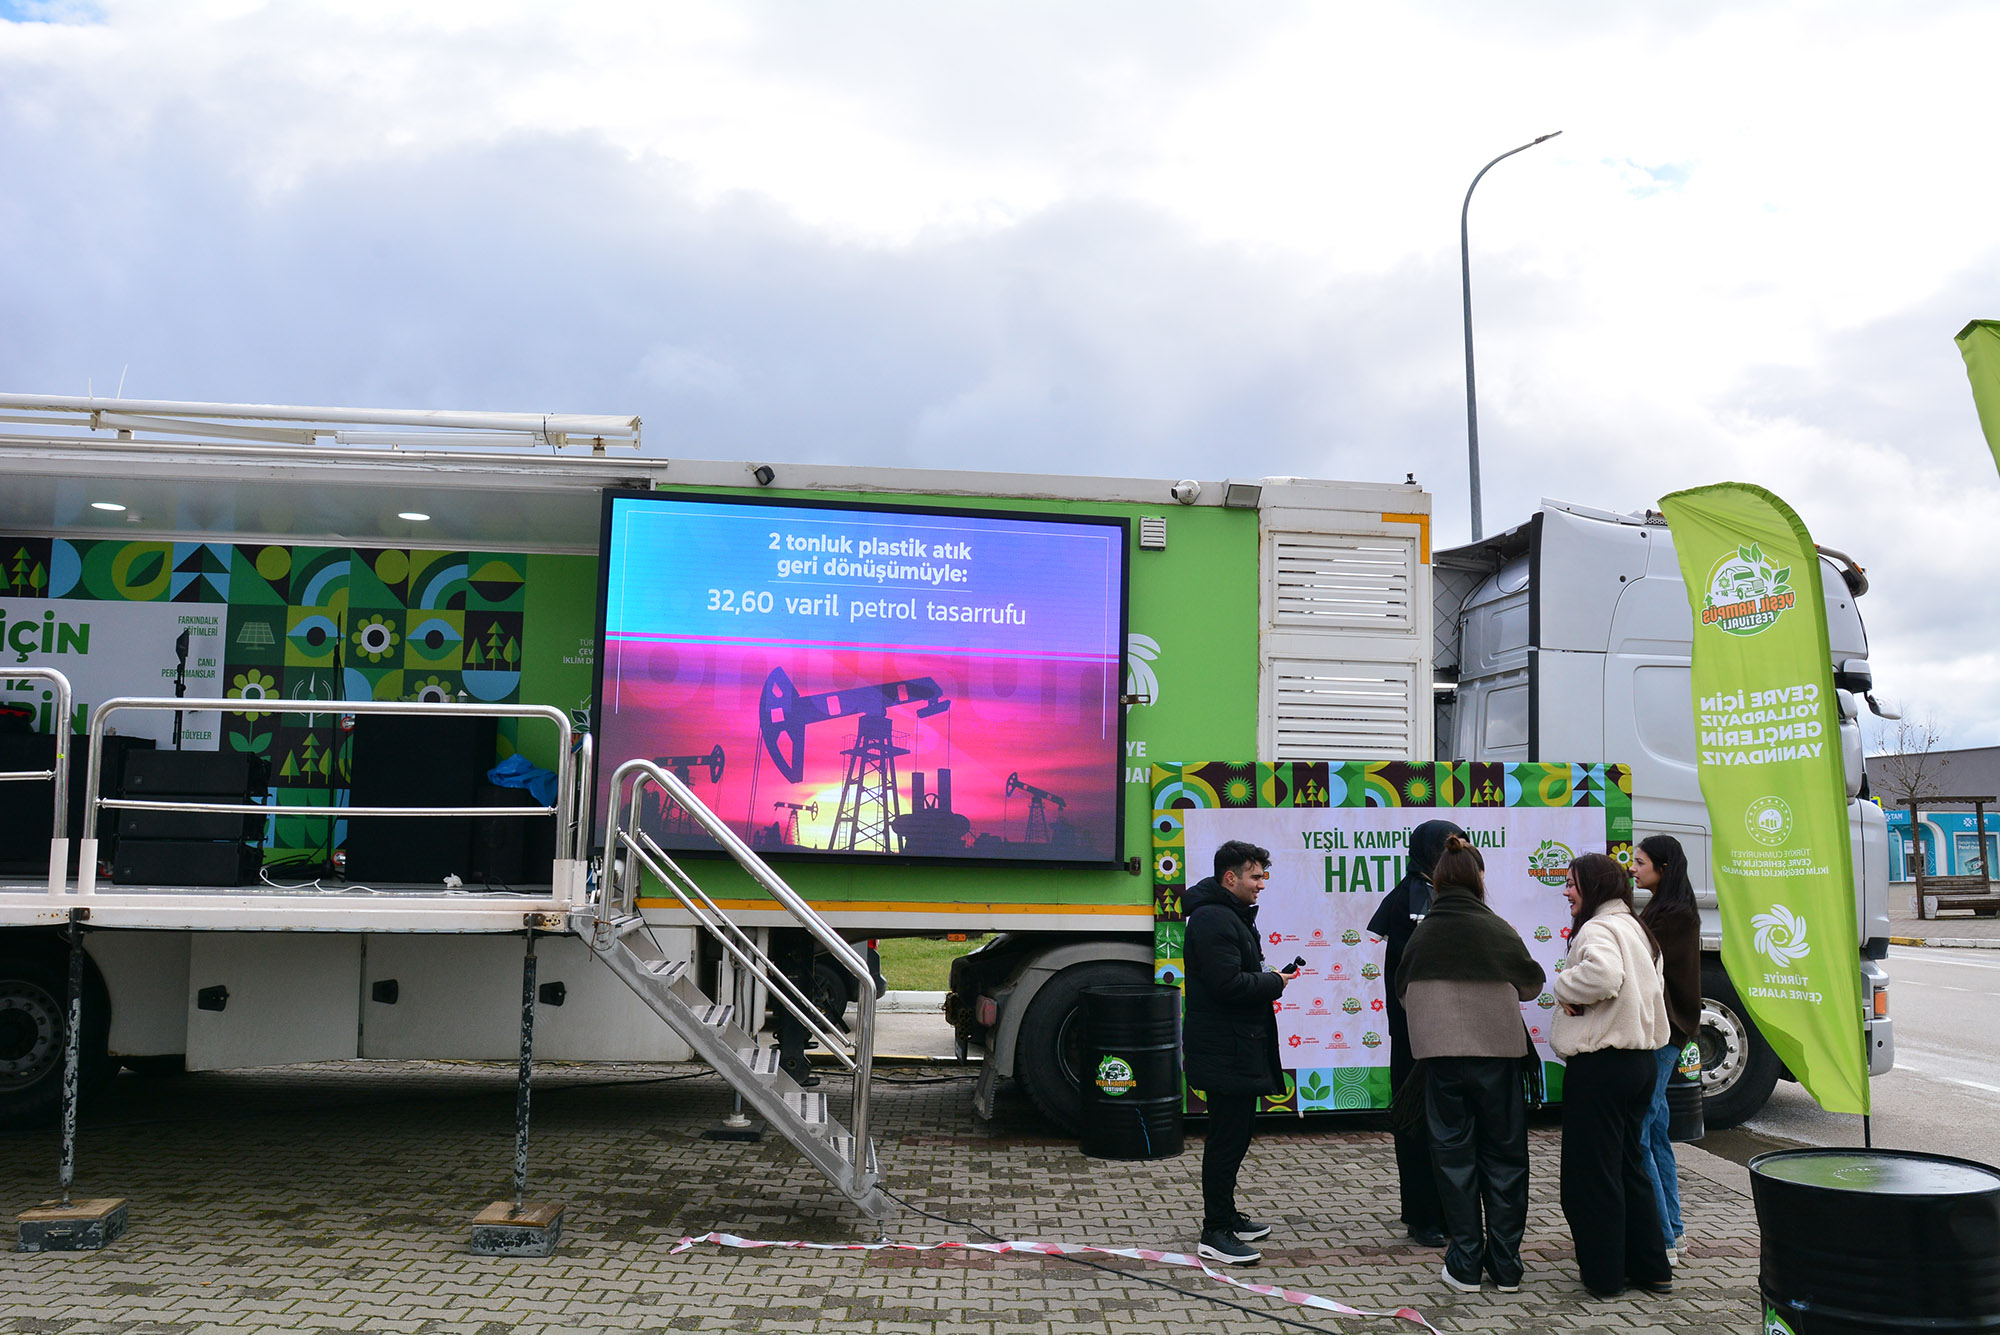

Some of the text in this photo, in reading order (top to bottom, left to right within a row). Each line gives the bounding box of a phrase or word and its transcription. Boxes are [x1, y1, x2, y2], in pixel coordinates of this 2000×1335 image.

[768, 532, 972, 560] 2 tonluk plastik atık
[777, 557, 968, 585] geri dönüşümüyle:
[707, 589, 1026, 625] 32,60 varil petrol tasarrufu
[182, 728, 212, 741] TÖLYELER
[1126, 741, 1147, 757] YE
[1301, 827, 1349, 853] YEŞİL
[1353, 827, 1412, 849] KAMPÜ
[1324, 855, 1409, 893] HATI
